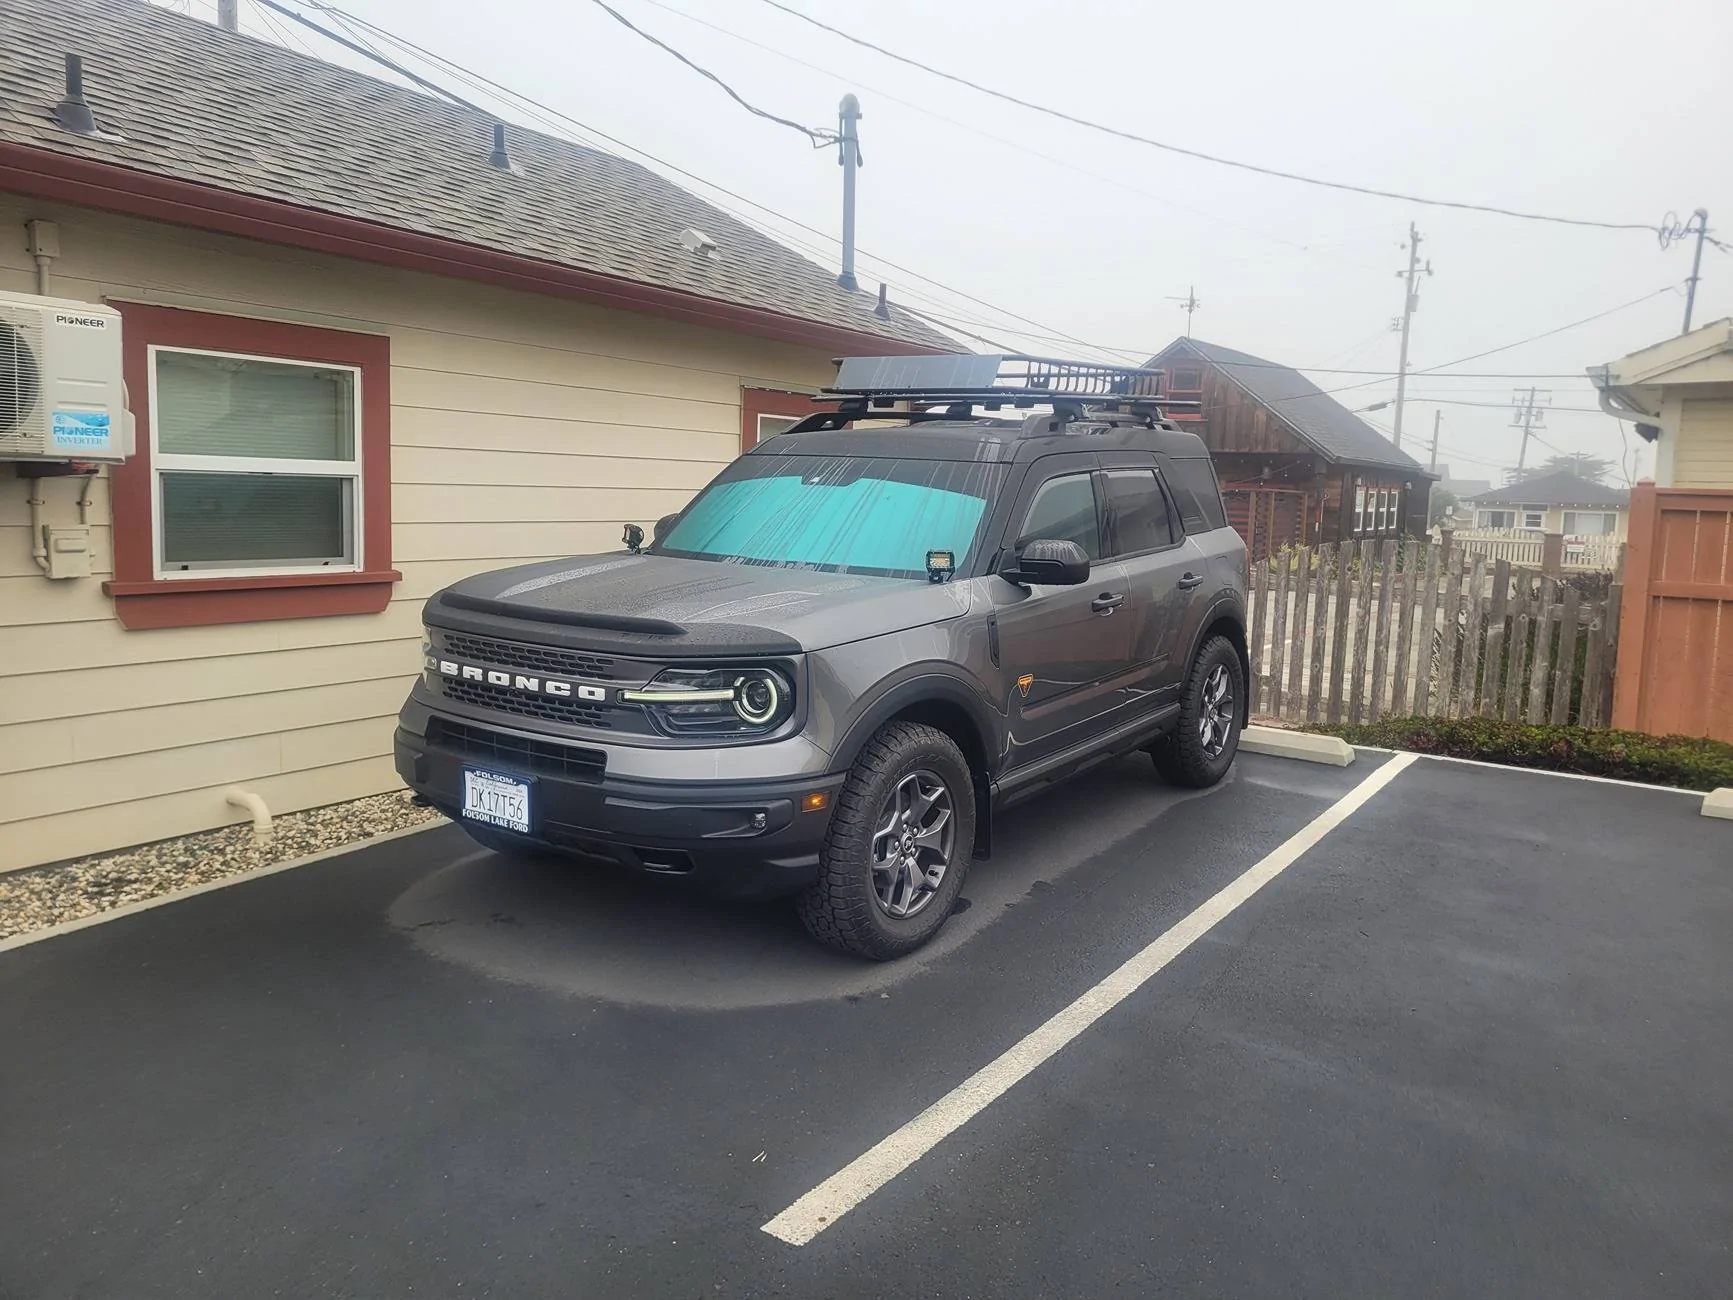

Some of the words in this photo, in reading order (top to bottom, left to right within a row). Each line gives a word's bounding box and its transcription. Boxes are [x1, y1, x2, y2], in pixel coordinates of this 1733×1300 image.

[56, 315, 105, 328] PIONEER
[53, 426, 109, 437] PIONEER
[440, 660, 606, 702] BRONCO
[471, 786, 523, 821] DK17T56
[462, 808, 490, 823] FOLSOM
[491, 815, 508, 828] LAKE
[509, 821, 529, 833] FORD
